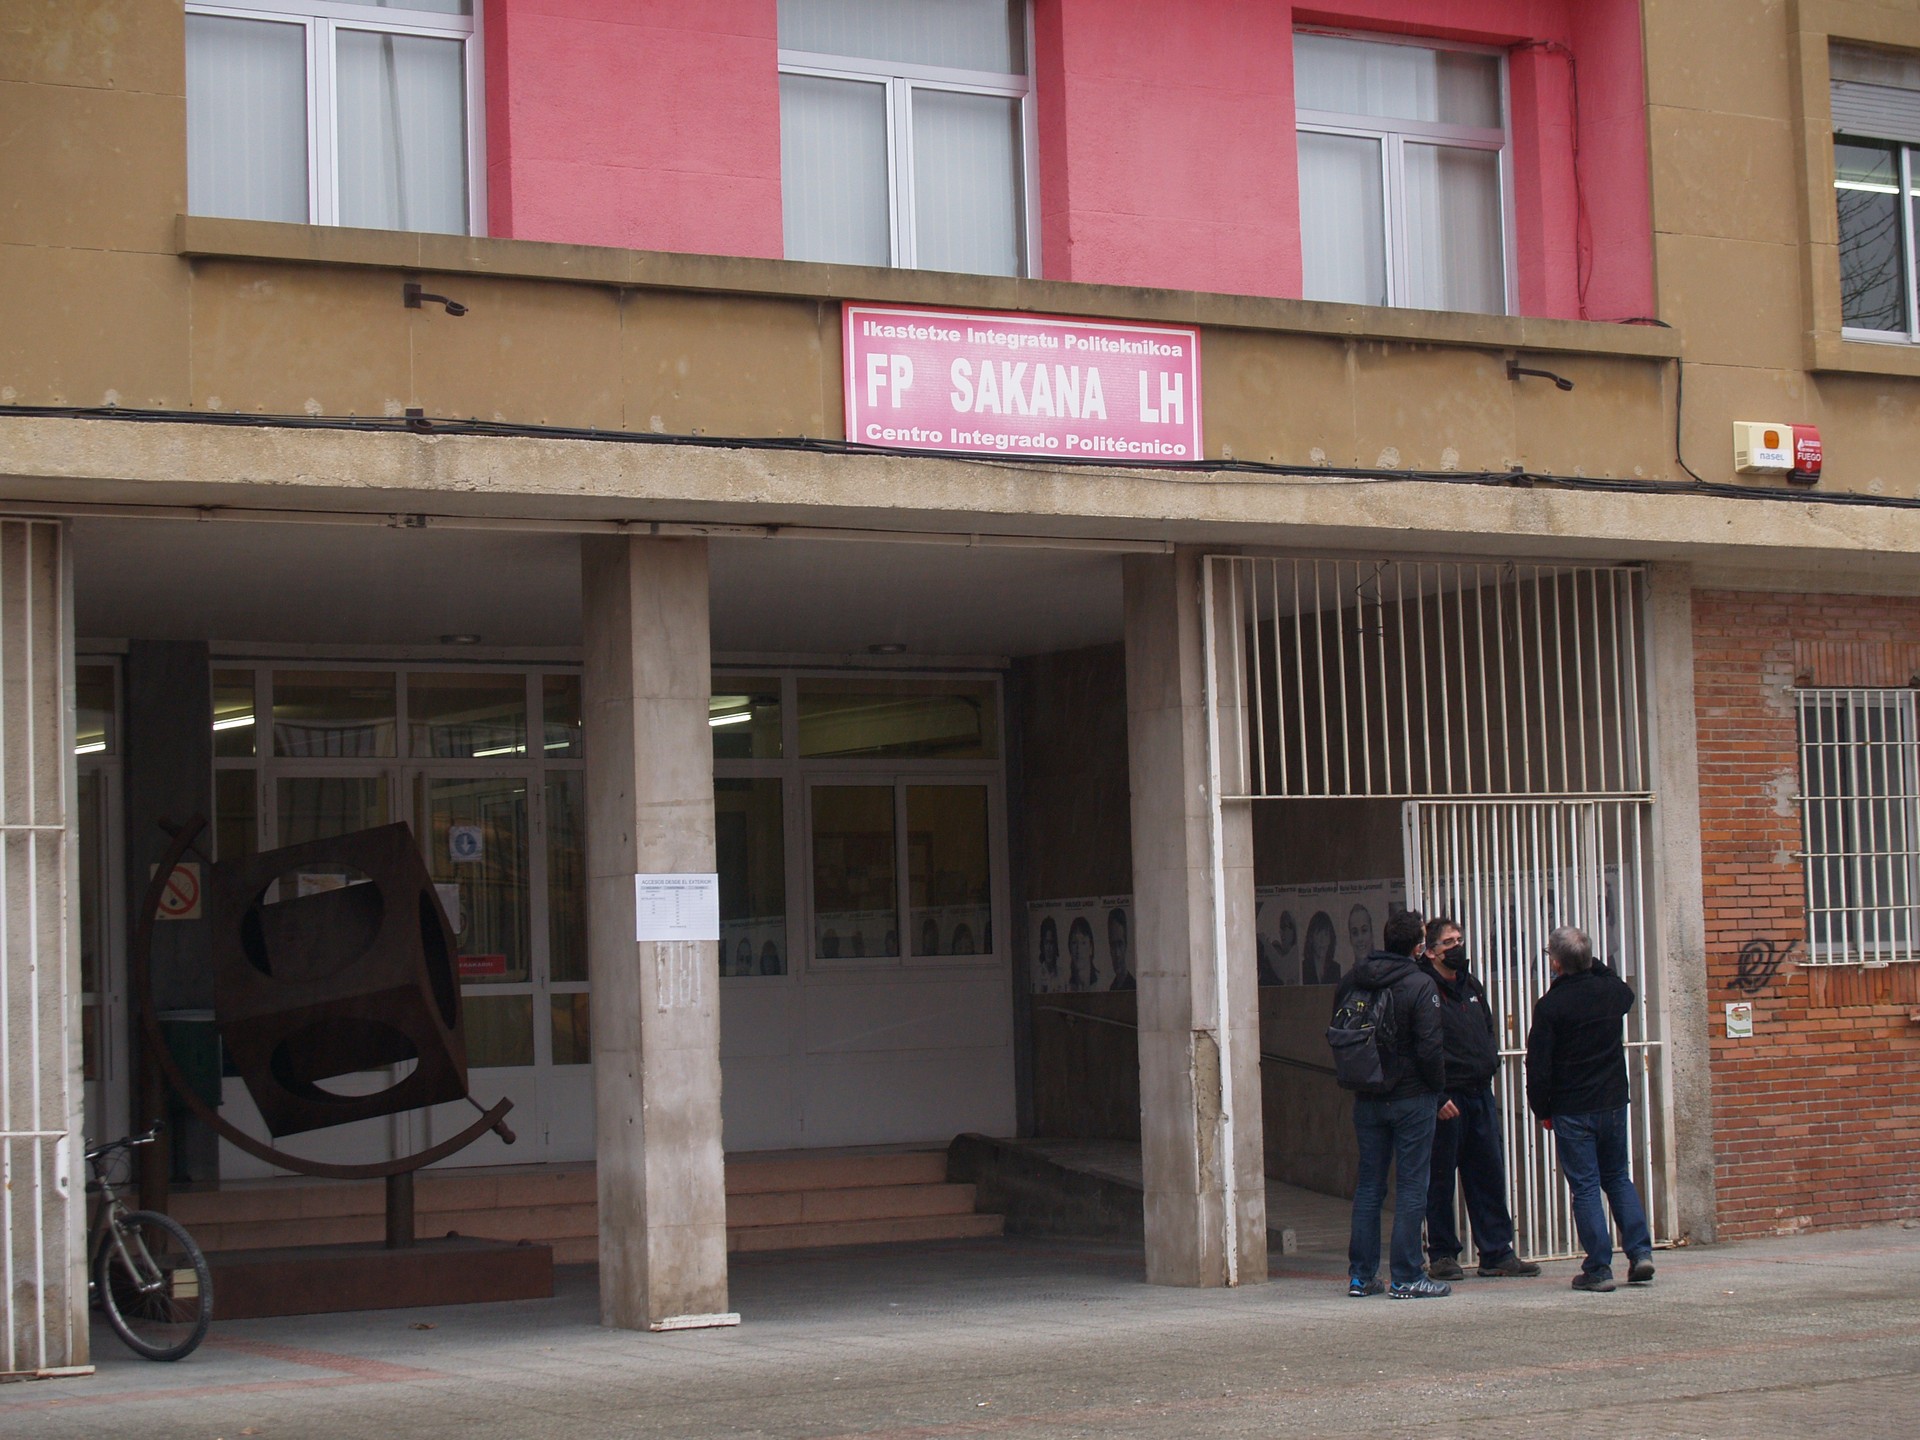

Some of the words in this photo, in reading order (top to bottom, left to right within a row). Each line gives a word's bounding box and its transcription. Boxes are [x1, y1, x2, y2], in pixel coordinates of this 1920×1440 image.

[863, 320, 961, 342] Ikastetxe
[967, 327, 1059, 350] Integratu
[1064, 333, 1183, 357] Politeknikoa
[866, 353, 914, 408] FP
[950, 357, 1107, 420] SAKANA
[1139, 370, 1184, 425] LH
[866, 423, 943, 443] Centro
[950, 427, 1059, 450] Integrado
[1066, 434, 1187, 456] Politécnico
[1797, 452, 1822, 462] FUEGO
